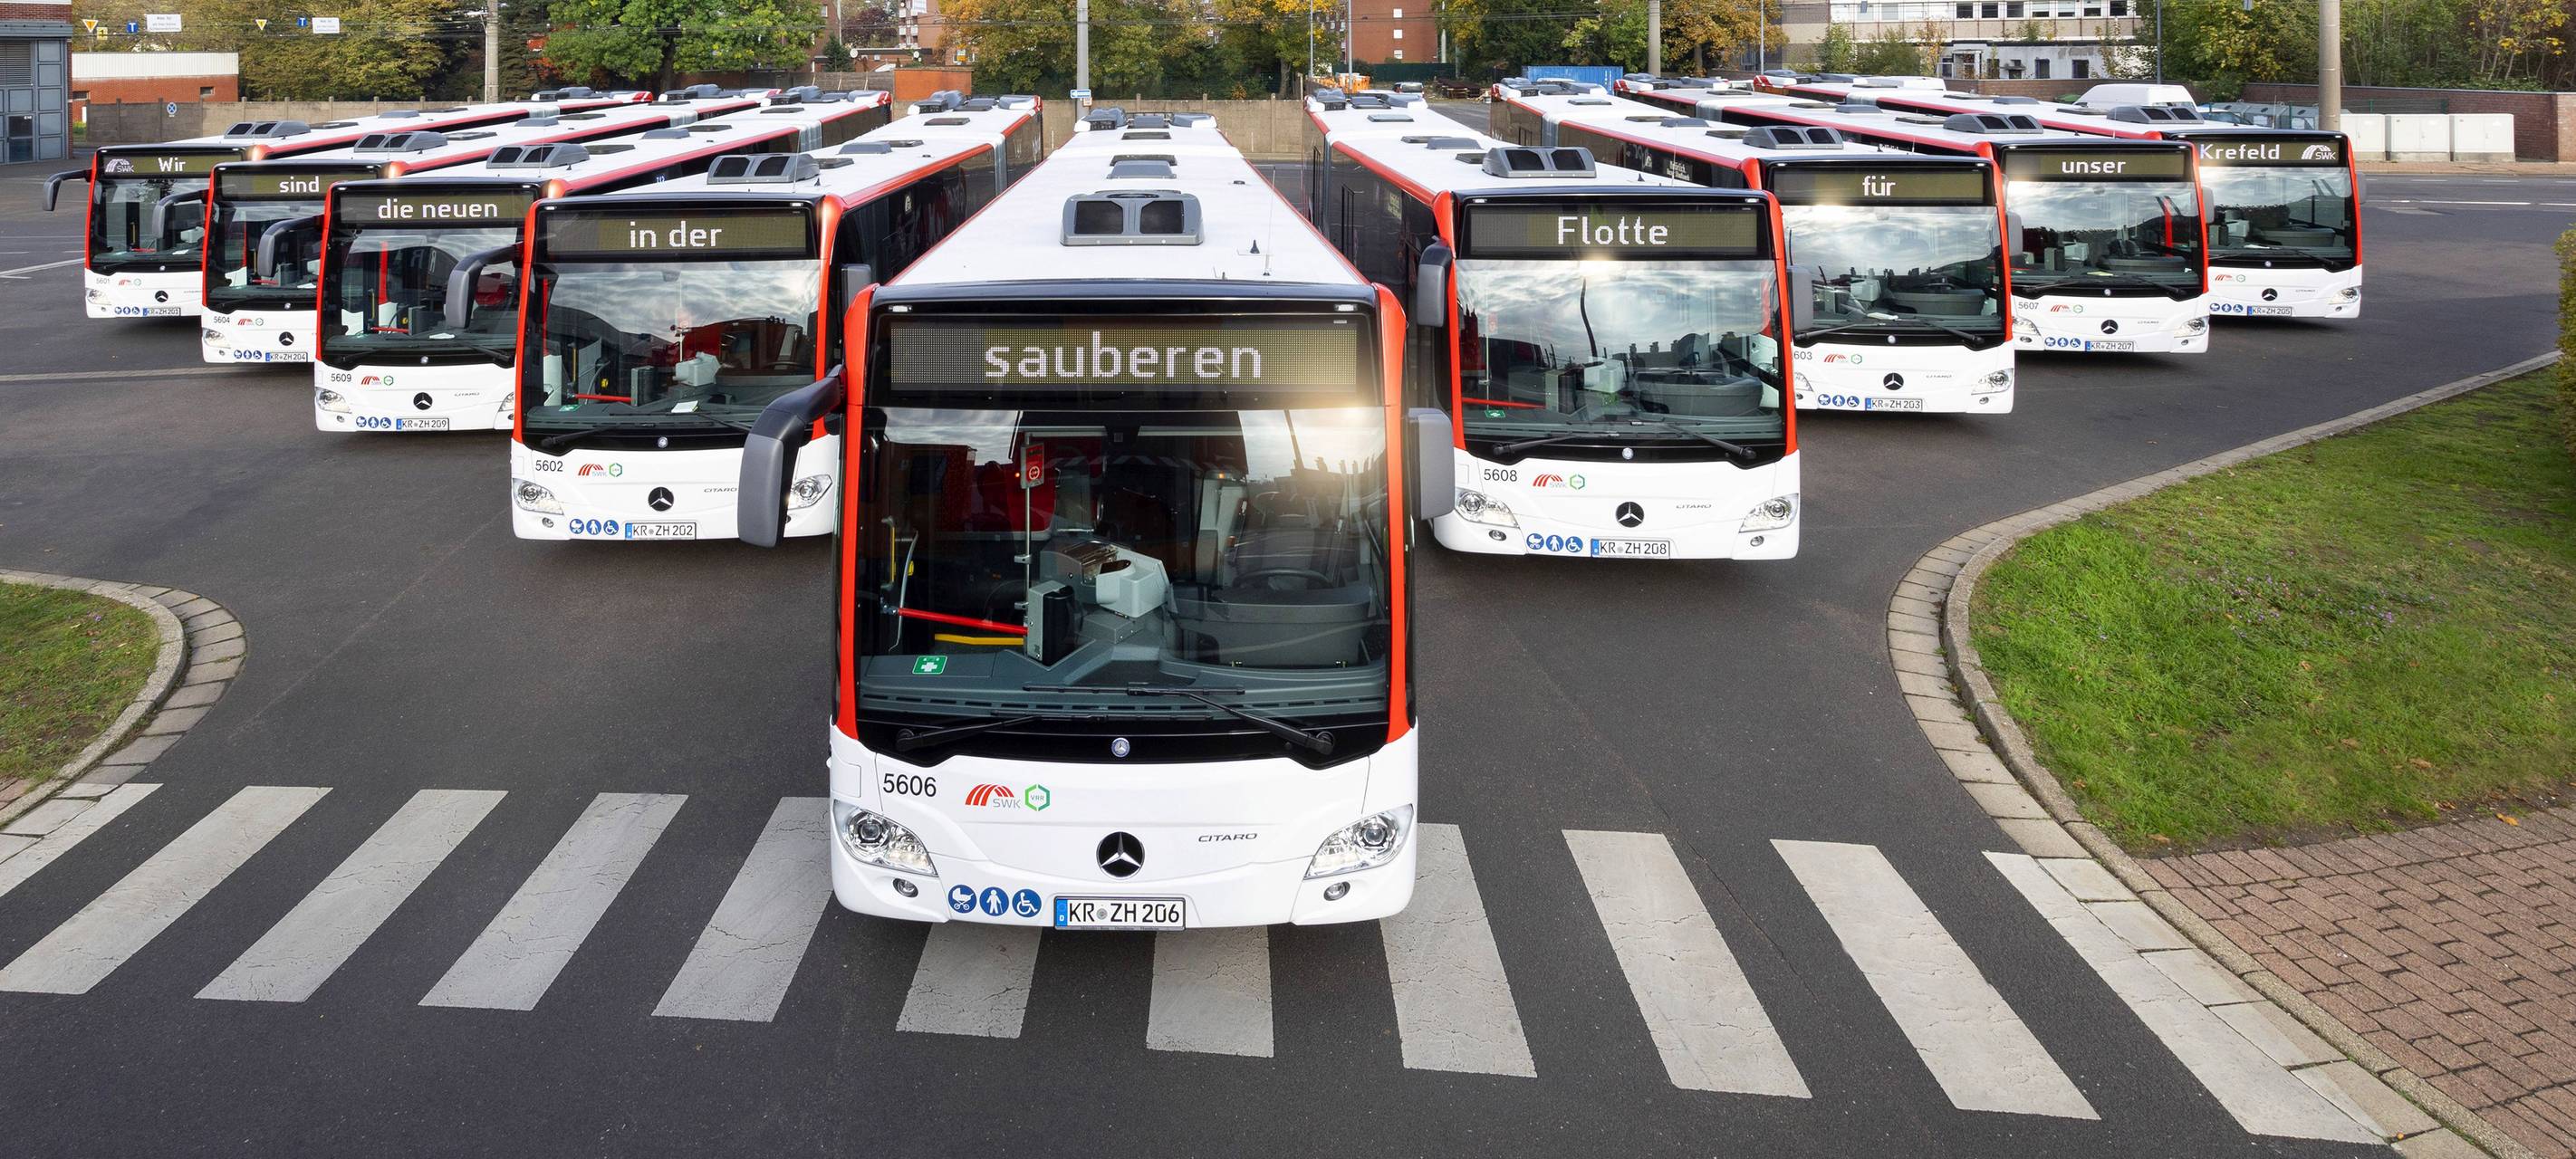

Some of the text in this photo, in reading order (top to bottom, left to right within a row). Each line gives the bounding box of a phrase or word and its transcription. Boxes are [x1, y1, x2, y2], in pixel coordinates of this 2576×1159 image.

[2200, 144, 2281, 159] Krefeld
[2315, 151, 2336, 159] SWK
[117, 165, 135, 173] SWK
[158, 157, 186, 172] Wir
[2062, 160, 2127, 174] unser
[279, 176, 320, 193] sind
[1862, 175, 1896, 196] für
[378, 198, 497, 219] die neuen
[630, 220, 723, 247] in der
[1558, 216, 1668, 244] Flotte
[2018, 302, 2040, 310] 5607
[213, 316, 230, 324] 5604
[2091, 342, 2101, 350] KR
[985, 331, 1262, 378] sauberen
[1793, 351, 1812, 360] 603
[331, 373, 352, 382] 5609
[1871, 399, 1921, 409] KR ZH 203
[402, 419, 447, 428] KR ZH 209
[535, 459, 563, 472] 5602
[1484, 468, 1518, 482] 5608
[632, 525, 693, 536] KR ZH 202
[1600, 541, 1667, 555] KR ZH 208
[882, 772, 937, 797] 5606
[992, 798, 1022, 809] SWK
[1197, 832, 1258, 843] CITARO
[1069, 902, 1180, 923] KR ZH 206
